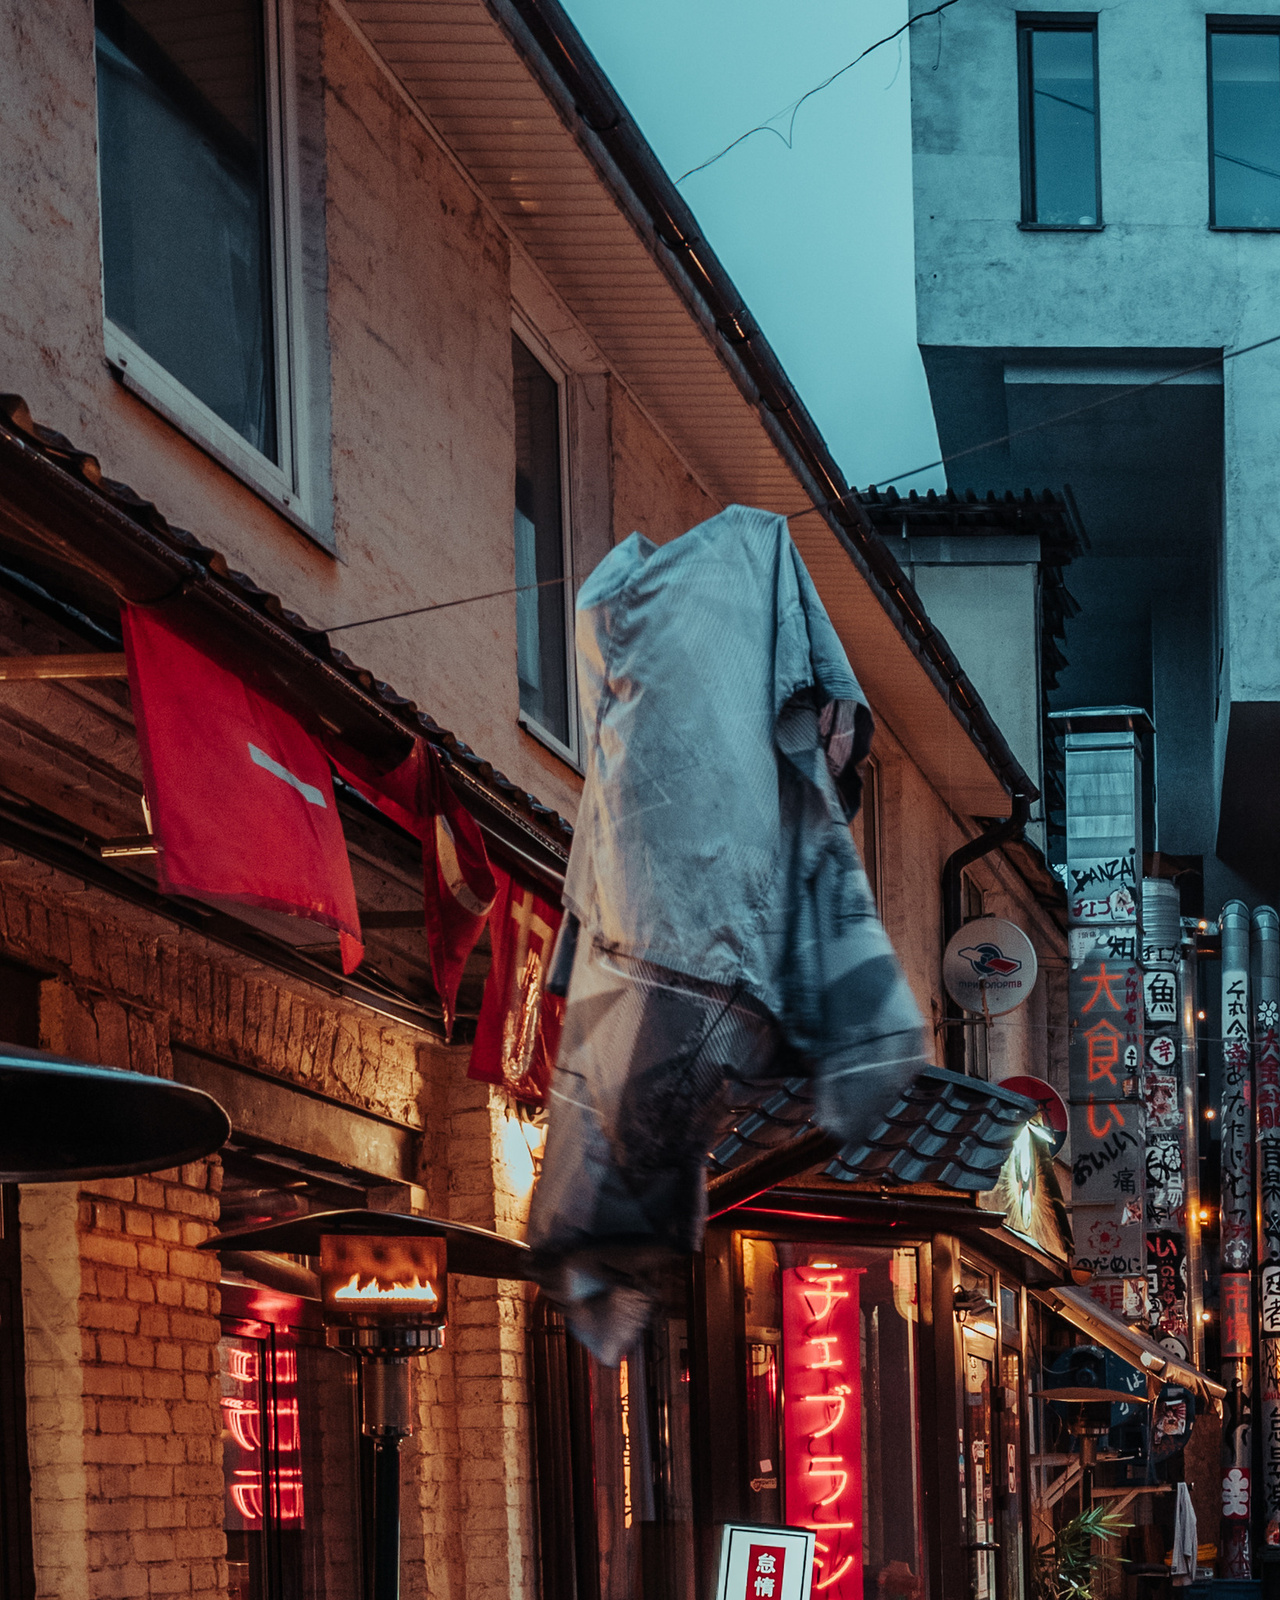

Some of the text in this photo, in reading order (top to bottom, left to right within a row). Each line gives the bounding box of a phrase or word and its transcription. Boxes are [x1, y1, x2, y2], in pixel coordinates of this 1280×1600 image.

[1148, 973, 1176, 1014] 魚
[1081, 962, 1127, 1139] 大食い
[1111, 1168, 1136, 1195] 痛
